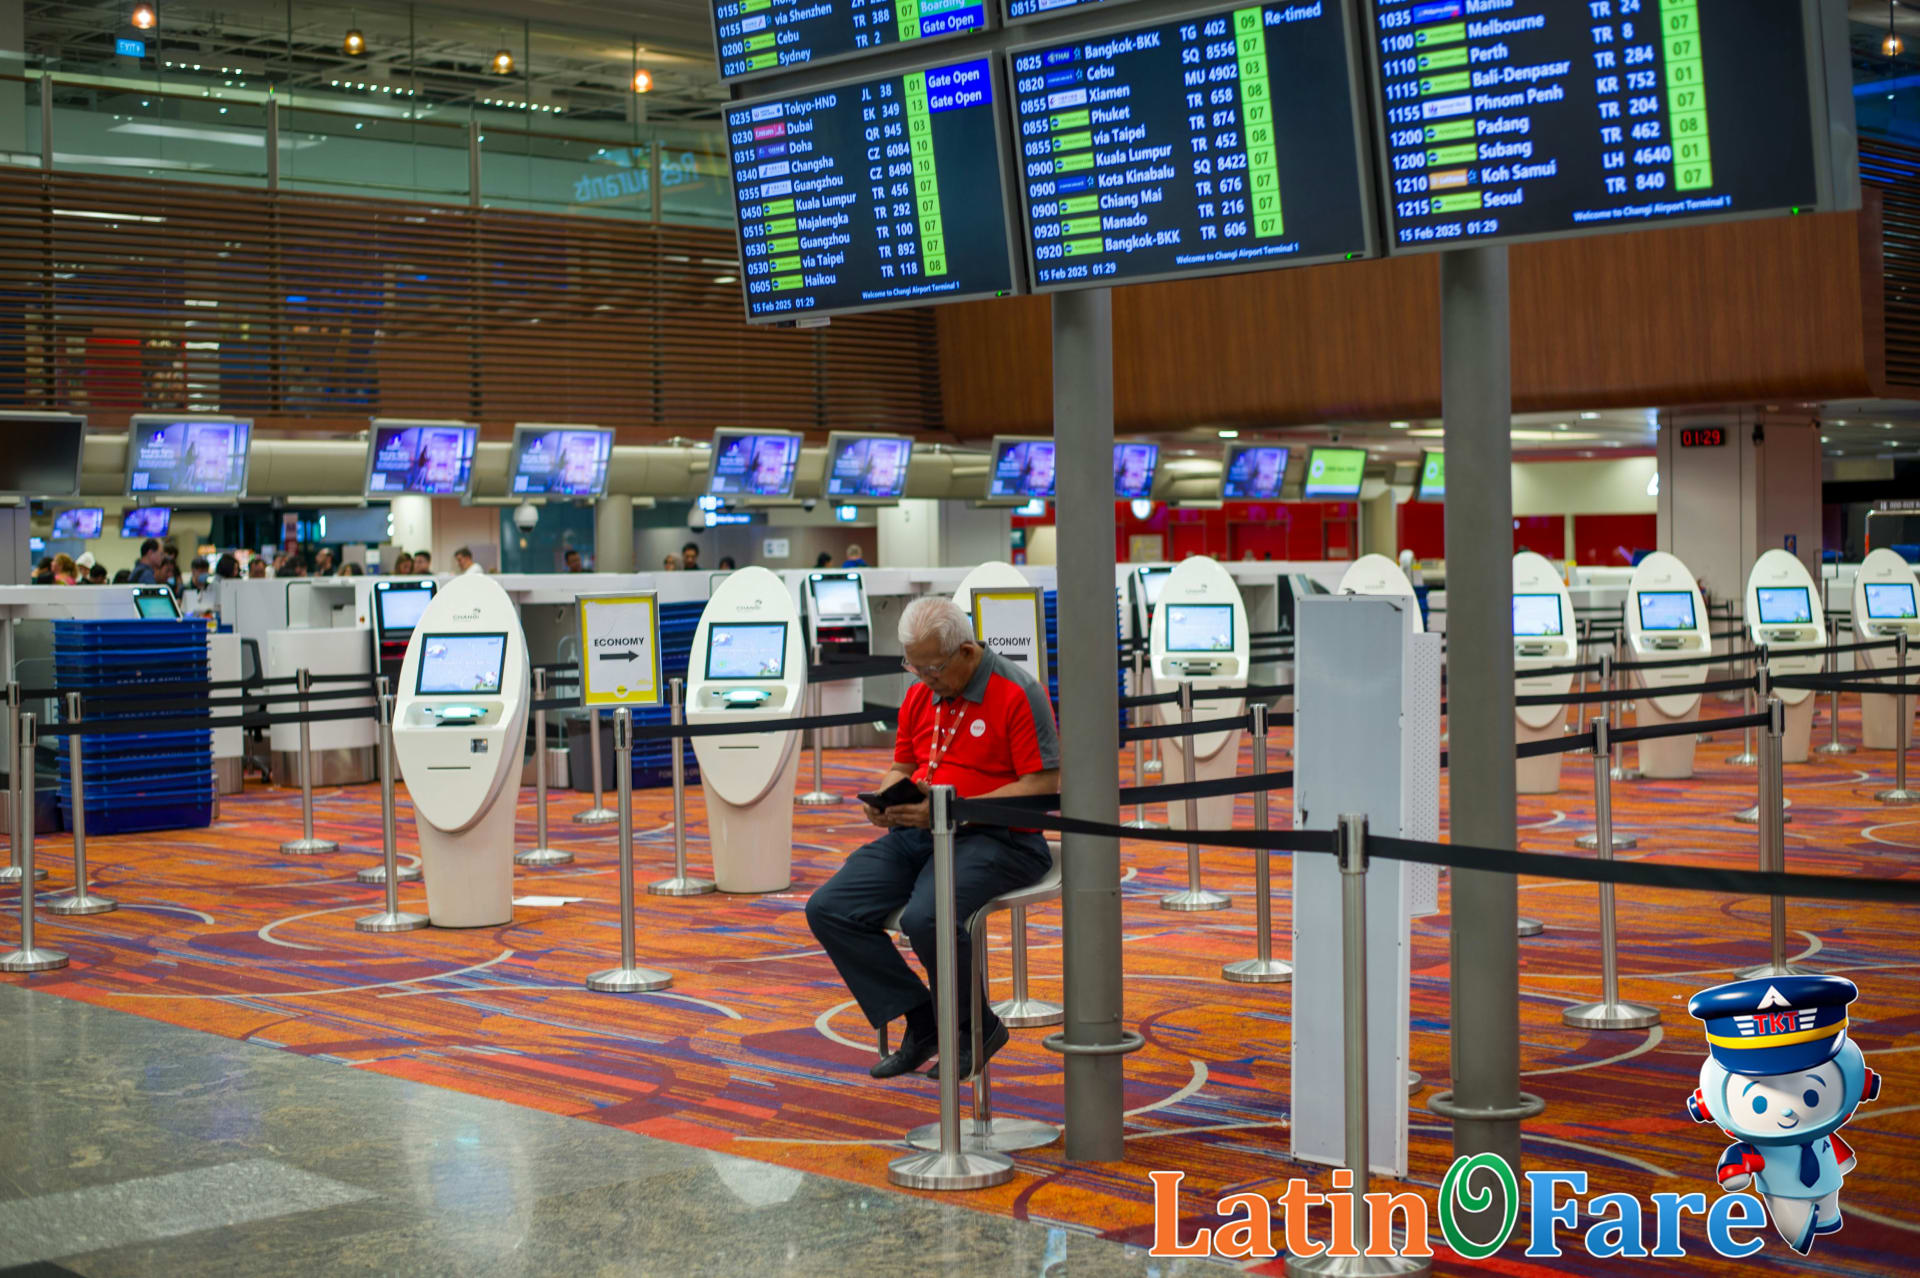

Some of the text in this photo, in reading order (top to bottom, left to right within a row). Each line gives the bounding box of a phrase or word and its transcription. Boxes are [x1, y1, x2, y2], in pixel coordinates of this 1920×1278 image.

[717, 3, 739, 18] 0155
[719, 22, 741, 38] 0155
[774, 11, 788, 25] via
[788, 3, 832, 22] Shenzhen
[1011, 1, 1037, 17] 0815
[1379, 9, 1411, 29] 1035
[1381, 0, 1640, 52] 1100 Melbourne 24
[722, 41, 743, 56] 0200
[776, 30, 800, 45] Cebu
[872, 8, 890, 24] 388
[724, 14, 974, 75] 0210 Sydney 2 Gate Open
[1016, 55, 1042, 71] 0825
[1084, 32, 1159, 59] Bangkok-BKK
[1180, 25, 1196, 40] TG
[1203, 20, 1225, 35] 402
[1240, 15, 1255, 29] 09
[1264, 1, 1321, 25] Re-timed
[1384, 22, 1633, 75] 1110 Perth 8
[1018, 76, 1044, 93] 0820
[1086, 64, 1115, 80] Cebu
[1182, 47, 1199, 63] SQ
[1206, 41, 1235, 59] 8556
[1020, 60, 1260, 114] 0855 Xiamen MU 4902 03
[1386, 45, 1653, 99] 1115 Bali-Denpasar 284
[729, 69, 980, 125] 0235 Tokyo-HND JL 38 01 Gate Open
[732, 128, 753, 144] 0230
[786, 118, 813, 135] Dubai
[863, 107, 875, 121] EK
[882, 102, 899, 118] 349
[911, 99, 923, 111] 13
[930, 95, 953, 108] Gate
[954, 90, 982, 106] Open
[1022, 87, 1233, 135] 0855 Phuket 658
[1388, 70, 1655, 123] 1155 Phnom Penh KR 752
[1025, 110, 1235, 156] 0855 via Taipei 874
[1390, 96, 1658, 146] 1200 Padang 204
[734, 148, 755, 163] 0315
[788, 139, 812, 154] Doha
[865, 127, 880, 141] QR
[883, 122, 902, 137] 945
[736, 141, 910, 182] 0340 Changsha CZ 6084
[1027, 132, 1237, 176] 0900 Kuala Lumpur 452
[1392, 117, 1698, 169] 1200 Subang 462 08
[738, 161, 912, 200] 0355 Guangzhou CZ 8490
[1029, 153, 1246, 197] 0900 Kota Kinabalu SQ 8422
[1395, 176, 1428, 193] 1210
[1481, 165, 1509, 183] Koh
[1511, 159, 1556, 179] Samui
[1603, 151, 1624, 168] LH
[1634, 145, 1671, 163] 4640
[740, 182, 908, 219] 0450 Kuala Lumpur 456
[1031, 176, 1242, 218] 0900 Chiang Mai 676
[1397, 172, 1665, 216] 1215 Seoul 840
[1573, 210, 1611, 220] Welcome
[1622, 205, 1652, 215] Changi
[1653, 201, 1685, 212] Airport
[1685, 197, 1724, 209] Terminal
[743, 202, 910, 238] 0515 Majalengka 292
[745, 222, 913, 256] 0530 Guangzhou 100
[1033, 199, 1244, 239] 0920 Manado 216
[1036, 221, 1246, 259] 0920 Bangkok-BKK 606
[1399, 219, 1498, 241] 15 Feb 2025 01:29
[747, 242, 915, 275] 0530 via Taipei 892
[749, 261, 918, 293] 0605 Haikou 118
[752, 296, 815, 312] 15 Feb 2025 01:29
[594, 637, 644, 647] ECONOMY
[988, 637, 1031, 646] ECONOMY
